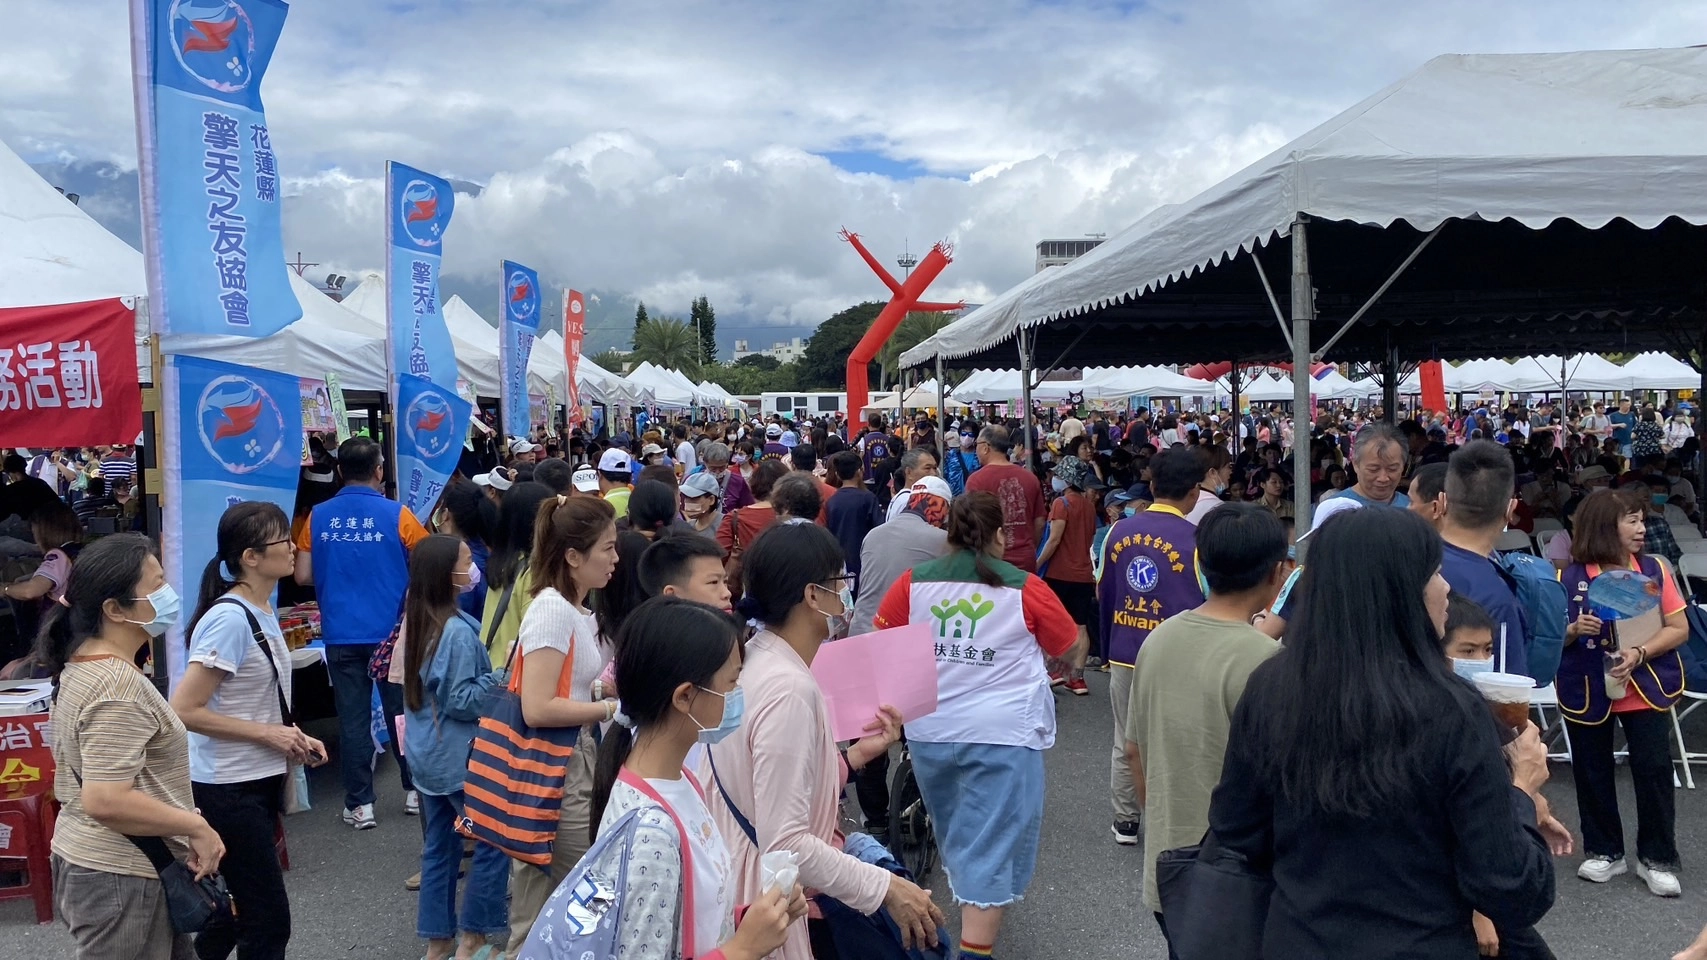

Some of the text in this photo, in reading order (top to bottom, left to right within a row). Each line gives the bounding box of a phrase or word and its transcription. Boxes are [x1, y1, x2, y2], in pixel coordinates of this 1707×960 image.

[250, 123, 275, 202] 花蓮縣
[203, 112, 250, 326] 擎天之友協會
[567, 320, 584, 335] YES
[329, 516, 375, 529] 花蓮縣
[320, 531, 385, 542] 擎天之友協會
[1113, 610, 1165, 630] Kiwan
